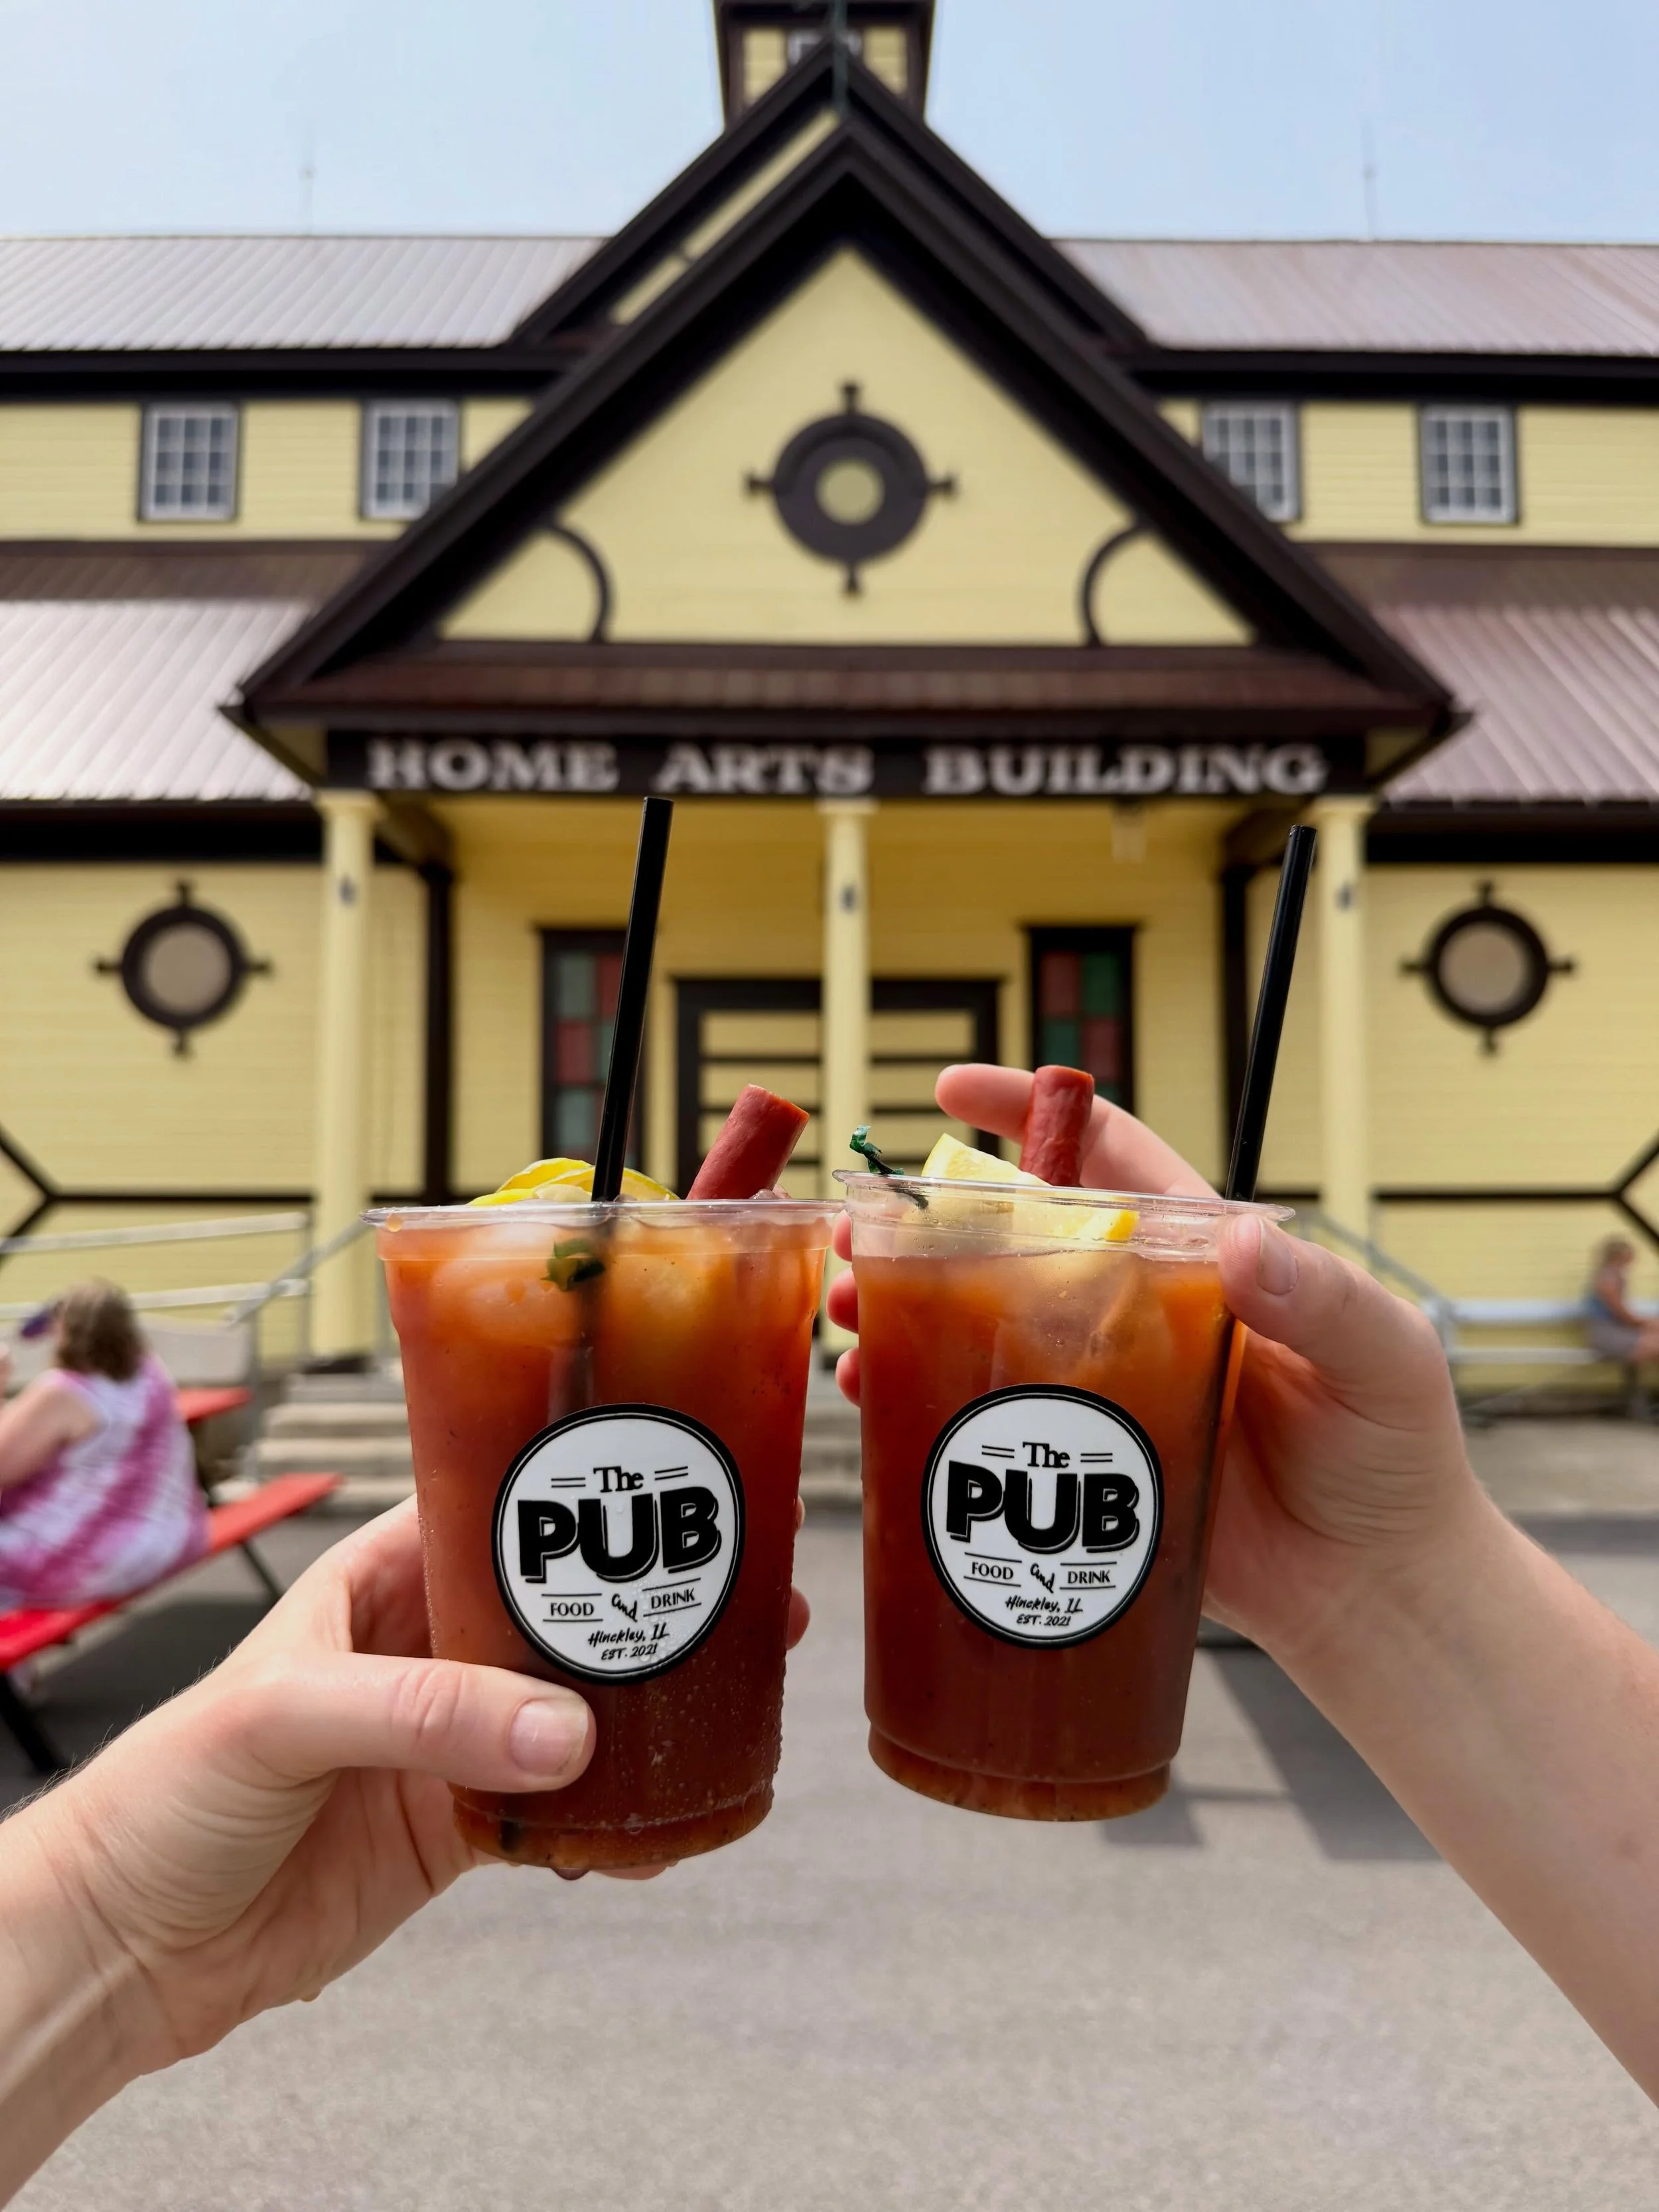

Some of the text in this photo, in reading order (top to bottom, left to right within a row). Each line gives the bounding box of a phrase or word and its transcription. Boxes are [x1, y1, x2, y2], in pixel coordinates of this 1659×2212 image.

[368, 739, 1326, 795] HOME ARTS BUILDING
[1023, 1441, 1070, 1468] The
[593, 1466, 644, 1493] The
[946, 1460, 1139, 1554] PUB
[518, 1487, 722, 1584] PUB
[972, 1562, 1111, 1593] FOOD and DRINK
[550, 1588, 695, 1622] FOOD and DRINK
[1005, 1595, 1083, 1613] Hinckley, IL
[1016, 1614, 1071, 1626] EST. 2021
[588, 1623, 670, 1647] Hinckley, IL
[601, 1643, 658, 1660] EST. 2021
